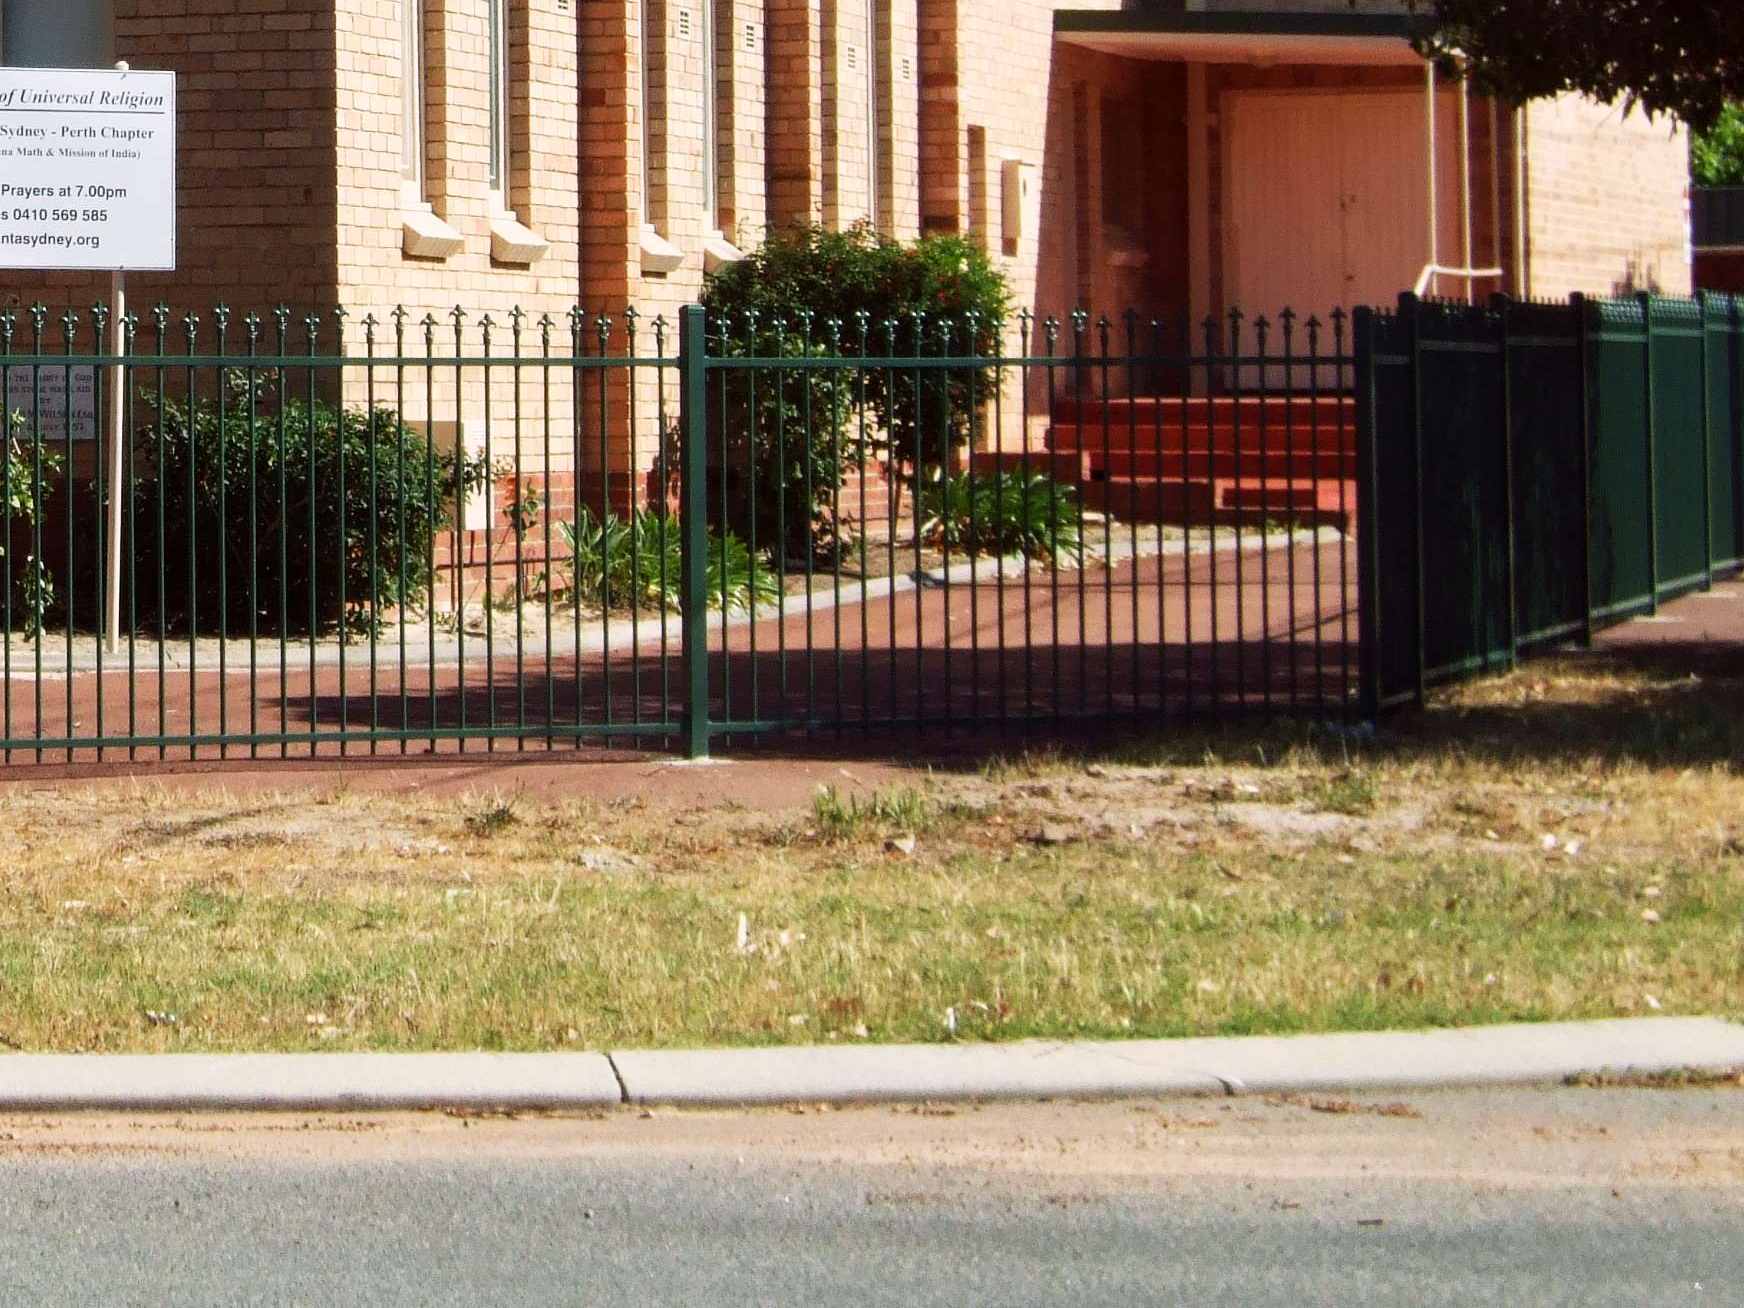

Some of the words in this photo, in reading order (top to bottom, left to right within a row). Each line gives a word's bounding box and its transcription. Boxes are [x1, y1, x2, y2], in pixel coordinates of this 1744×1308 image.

[20, 89, 95, 105] Universal
[99, 91, 164, 108] Religion
[0, 124, 46, 140] Sydney
[61, 126, 97, 138] Perth
[101, 126, 154, 141] Chapter
[17, 147, 43, 157] Math
[46, 148, 54, 157] &
[58, 148, 96, 158] Mission
[99, 149, 108, 158] of
[111, 149, 141, 160] India)
[1, 184, 54, 199] Prayers
[59, 186, 72, 197] at
[75, 185, 127, 201] 7.00pm
[13, 208, 48, 221] 0410
[52, 209, 78, 221] 569
[82, 209, 108, 222] 585
